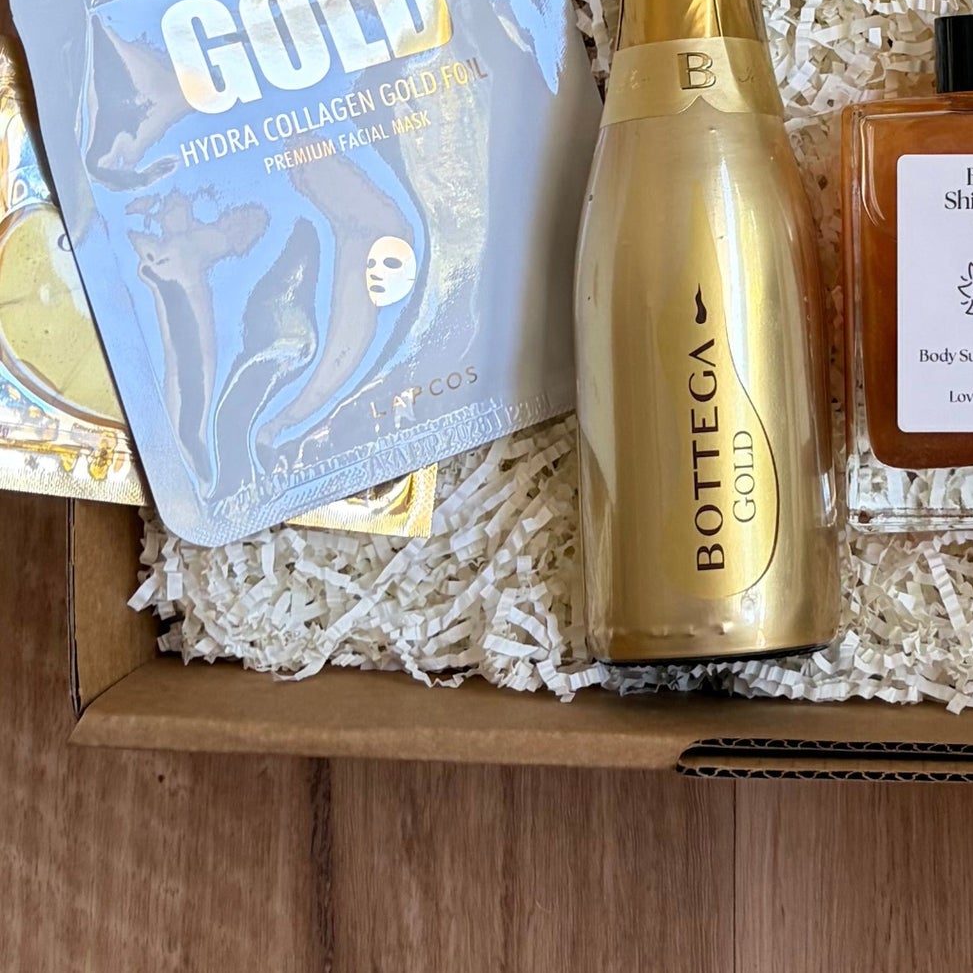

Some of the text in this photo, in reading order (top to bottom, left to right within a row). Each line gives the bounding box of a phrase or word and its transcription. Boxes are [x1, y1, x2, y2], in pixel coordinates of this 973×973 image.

[677, 52, 717, 90] B
[179, 57, 489, 168] HYDRA COLLAGEN GOLD FOIL
[263, 110, 432, 175] PREMIUM FACIAL MASK
[919, 348, 957, 365] Body
[370, 366, 478, 419] LAPCOS
[689, 338, 725, 571] BOTTEGA
[733, 430, 756, 523] GOLD
